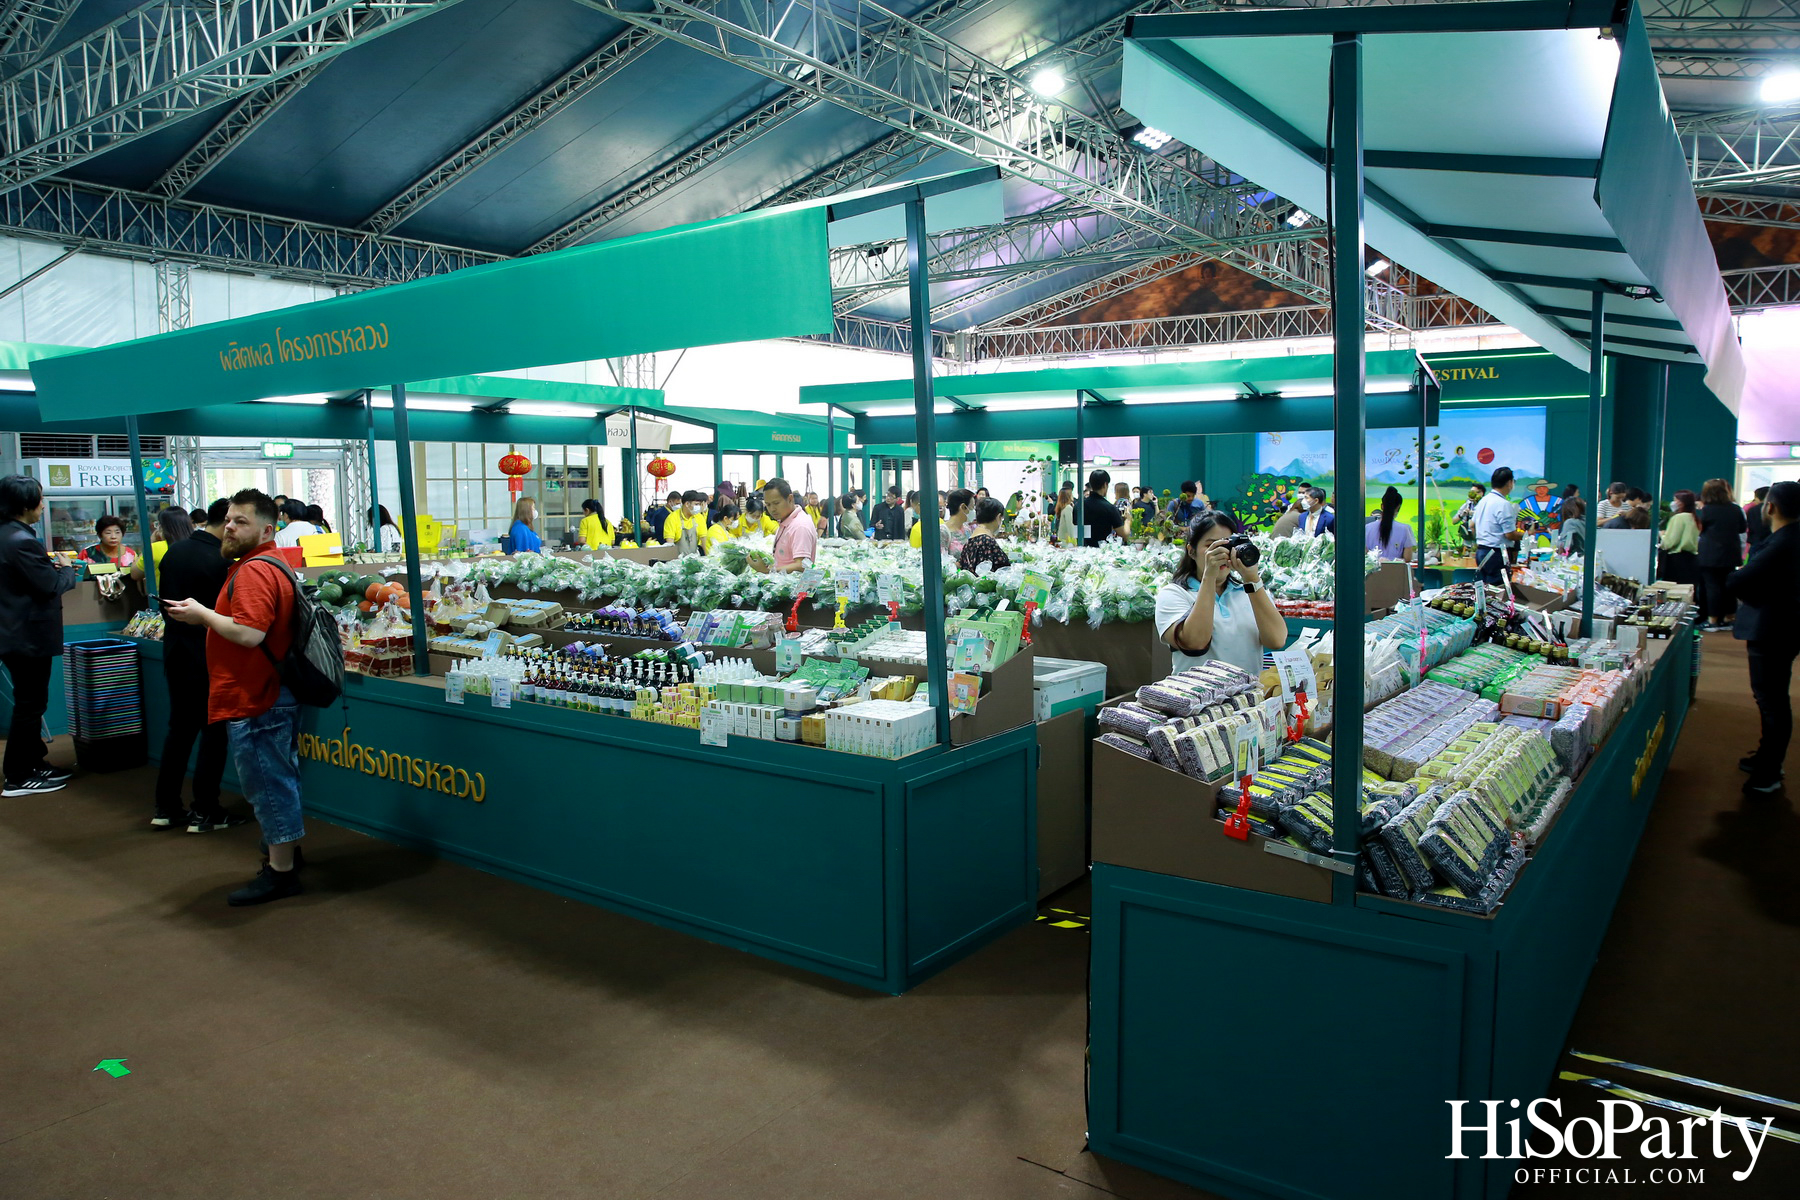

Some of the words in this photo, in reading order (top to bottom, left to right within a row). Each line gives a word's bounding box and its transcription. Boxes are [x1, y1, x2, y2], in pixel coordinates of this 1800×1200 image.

[276, 323, 389, 363] โครงการหลวง
[1432, 366, 1500, 381] ESTIVAL
[77, 464, 101, 472] ROYAL
[103, 464, 132, 473] PROJECT
[79, 472, 134, 488] FRESH
